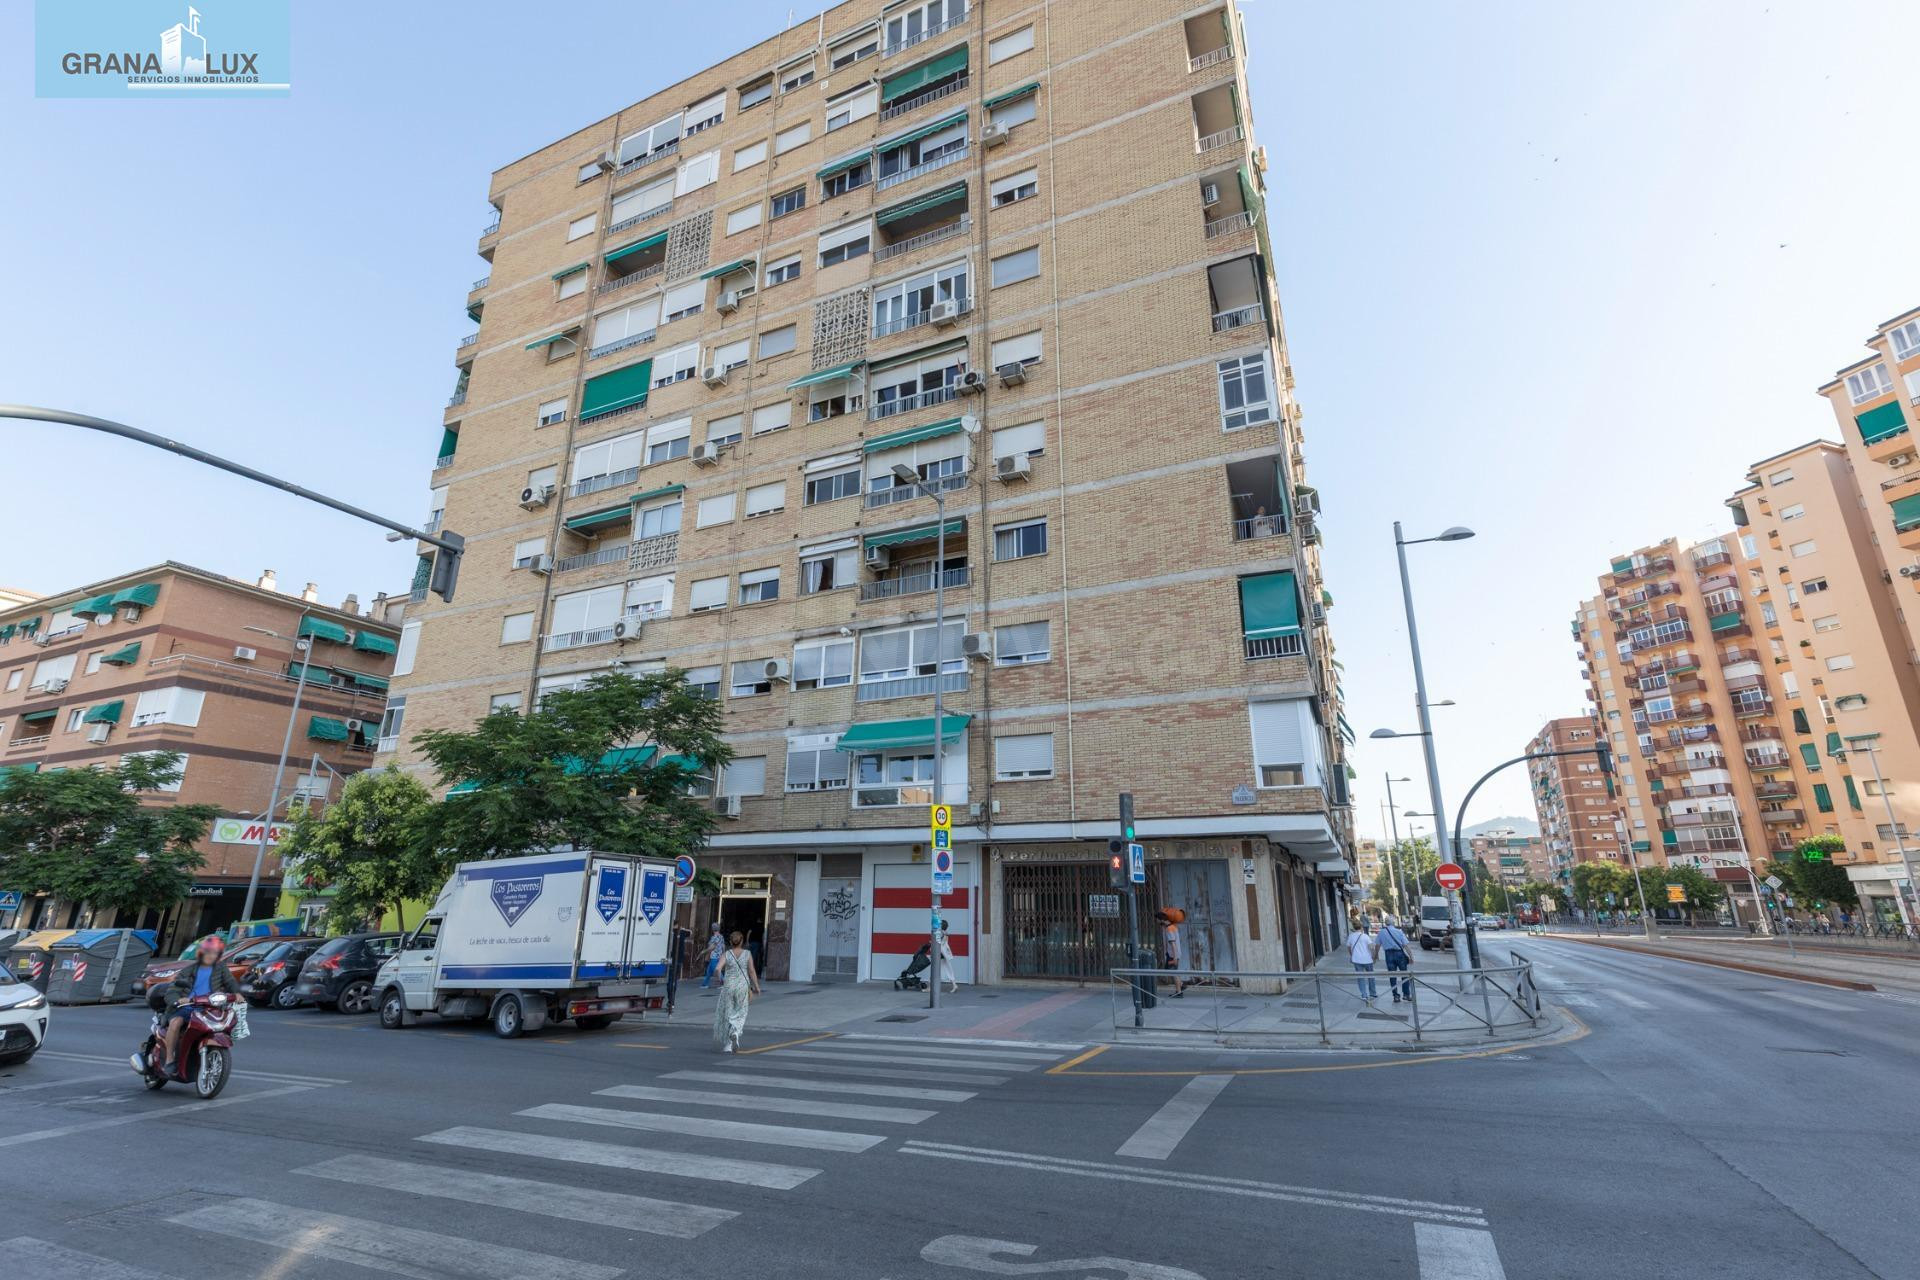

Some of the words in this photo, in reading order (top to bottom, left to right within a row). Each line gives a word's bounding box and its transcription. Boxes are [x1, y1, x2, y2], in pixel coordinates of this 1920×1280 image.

[241, 825, 289, 842] MA
[190, 886, 223, 895] CaixaBank
[494, 882, 506, 894] Los
